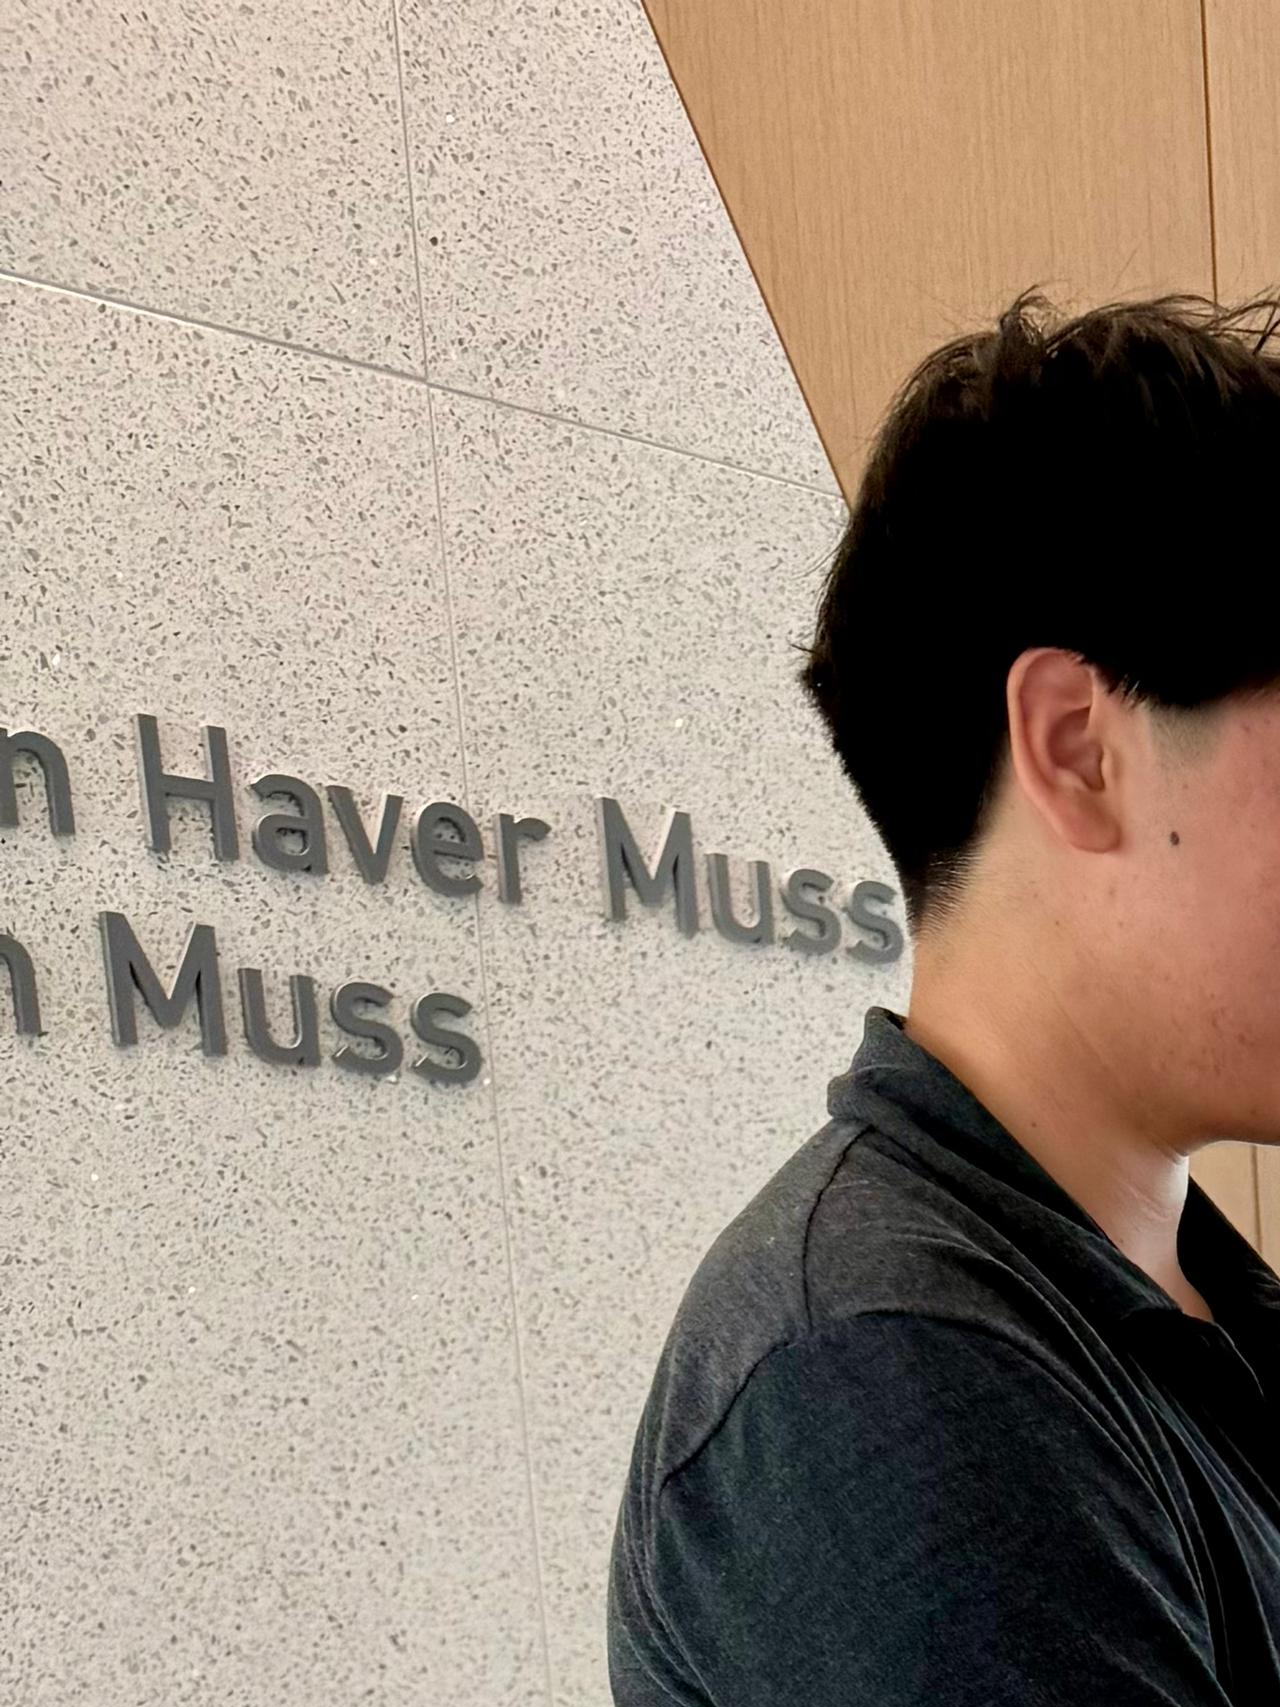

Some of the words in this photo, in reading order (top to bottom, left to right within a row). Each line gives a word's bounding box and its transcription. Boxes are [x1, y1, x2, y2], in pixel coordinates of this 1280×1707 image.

[131, 712, 552, 906] Haver
[598, 796, 907, 965] Muss
[98, 910, 484, 1085] Muss
